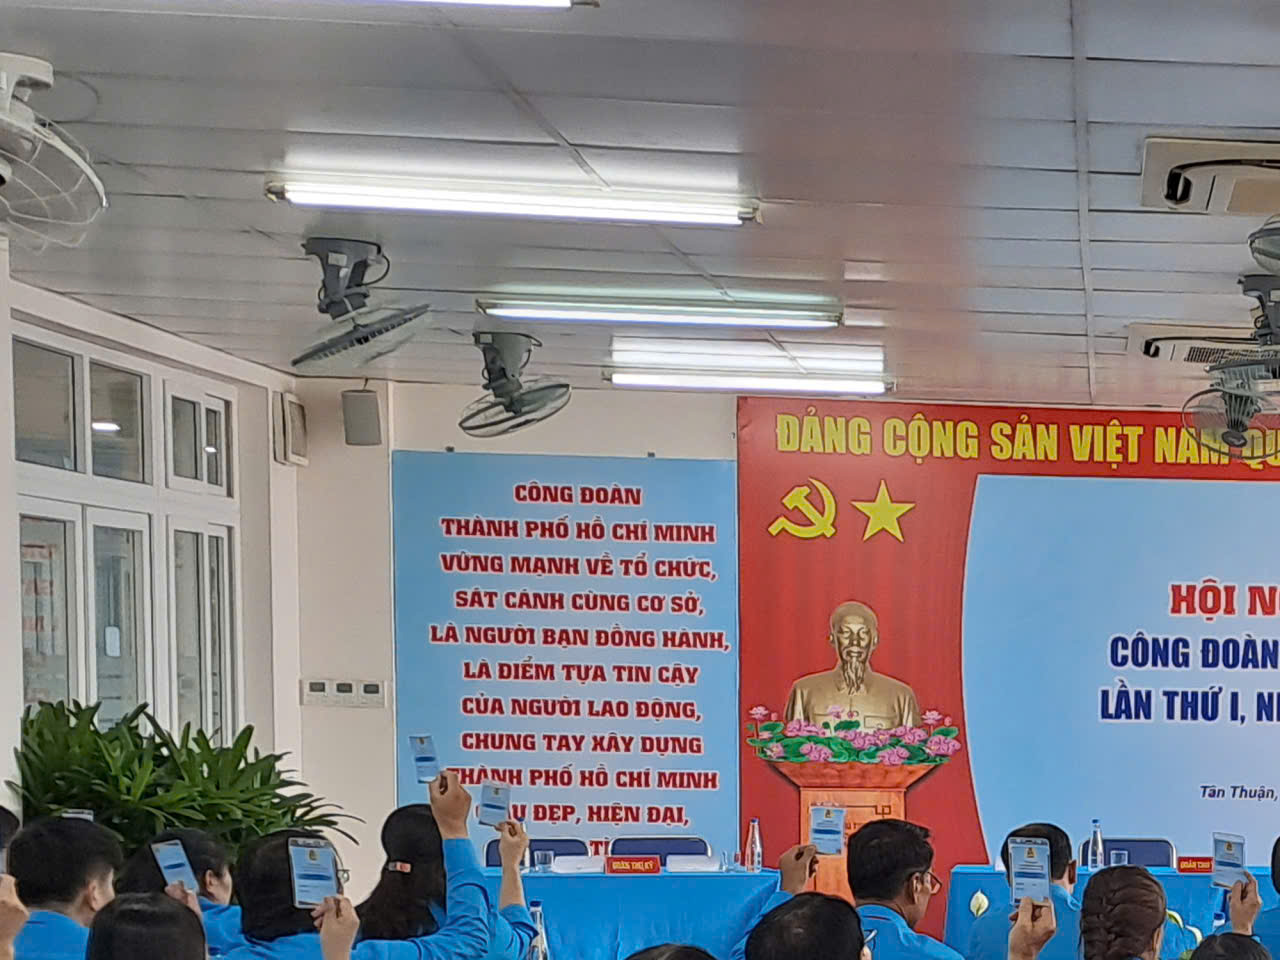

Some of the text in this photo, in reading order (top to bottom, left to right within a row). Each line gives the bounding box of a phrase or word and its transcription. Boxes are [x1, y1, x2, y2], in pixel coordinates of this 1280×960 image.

[776, 407, 871, 455] ĐẢNG
[884, 415, 978, 463] CỘNG
[991, 415, 1058, 461] SẢN
[1070, 422, 1144, 469] VIỆT
[1155, 427, 1230, 464] NAM
[514, 481, 642, 505] CÔNG ĐOÀN
[441, 515, 715, 542] THÀNH PHỐ HỒ CHÍ MINH
[441, 551, 717, 581] VỮNG MẠNH VỀ TỔ CHỨC,
[456, 587, 704, 616] SÁT CÁNH CÙNG CƠ SỞ,
[1170, 578, 1236, 624] HỘI
[430, 622, 730, 651] LÀ NGƯỜI BẠN ĐỒNG HÀNH,
[1111, 634, 1190, 669] CÔNG
[1200, 636, 1279, 671] ĐOÀN
[464, 656, 698, 686] LÀ ĐIỂM TỰA TIN CẬY
[462, 693, 702, 721] CỦA NGƯỜI LAO ĐỘNG,
[1100, 679, 1153, 721] LẦN
[1163, 686, 1220, 723] THỨ
[1230, 694, 1246, 727] I,
[461, 732, 702, 756] CHUNG TAY XÂY DỰNG
[530, 764, 572, 786] PHỐ
[580, 764, 608, 787] HỒ
[616, 768, 650, 788] CHÍ
[657, 772, 718, 789] MINH
[1200, 786, 1225, 798] Tân
[1231, 786, 1278, 801] Thuận,
[534, 805, 581, 824] ĐẸP,
[587, 803, 640, 825] HIỆN
[647, 806, 688, 827] ĐẠI,
